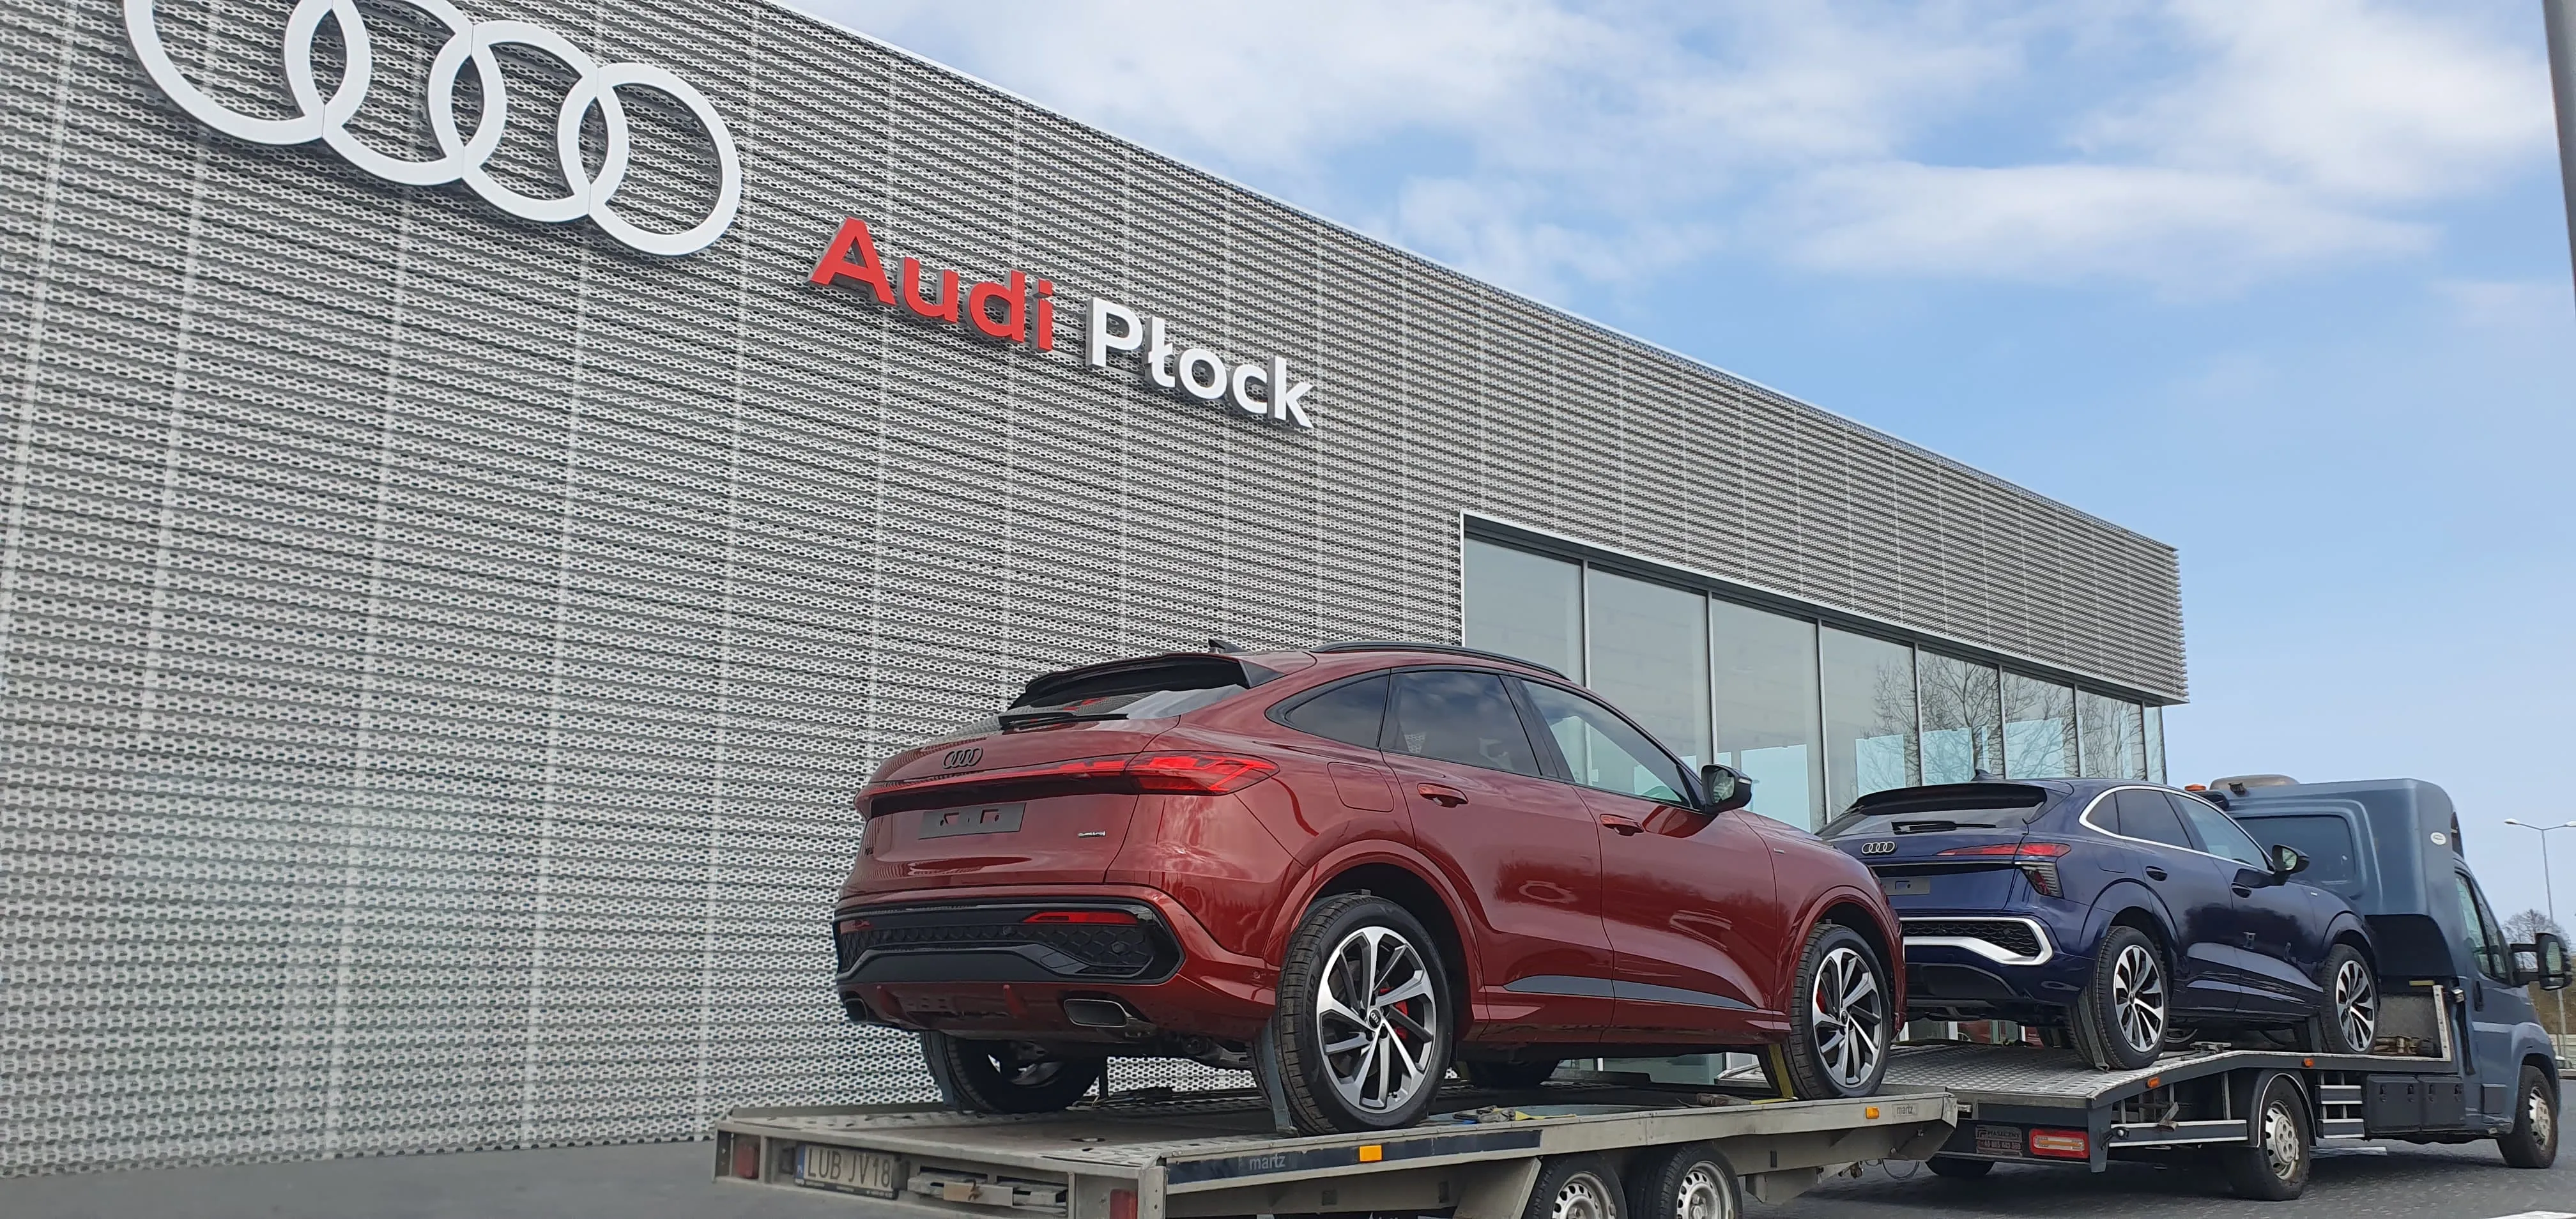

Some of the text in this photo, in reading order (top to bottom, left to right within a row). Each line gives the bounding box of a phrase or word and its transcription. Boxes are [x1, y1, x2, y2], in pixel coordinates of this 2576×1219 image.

[808, 216, 1314, 429] Audi Płock
[808, 1148, 891, 1188] LUB JV18
[1249, 1153, 1286, 1170] martz
